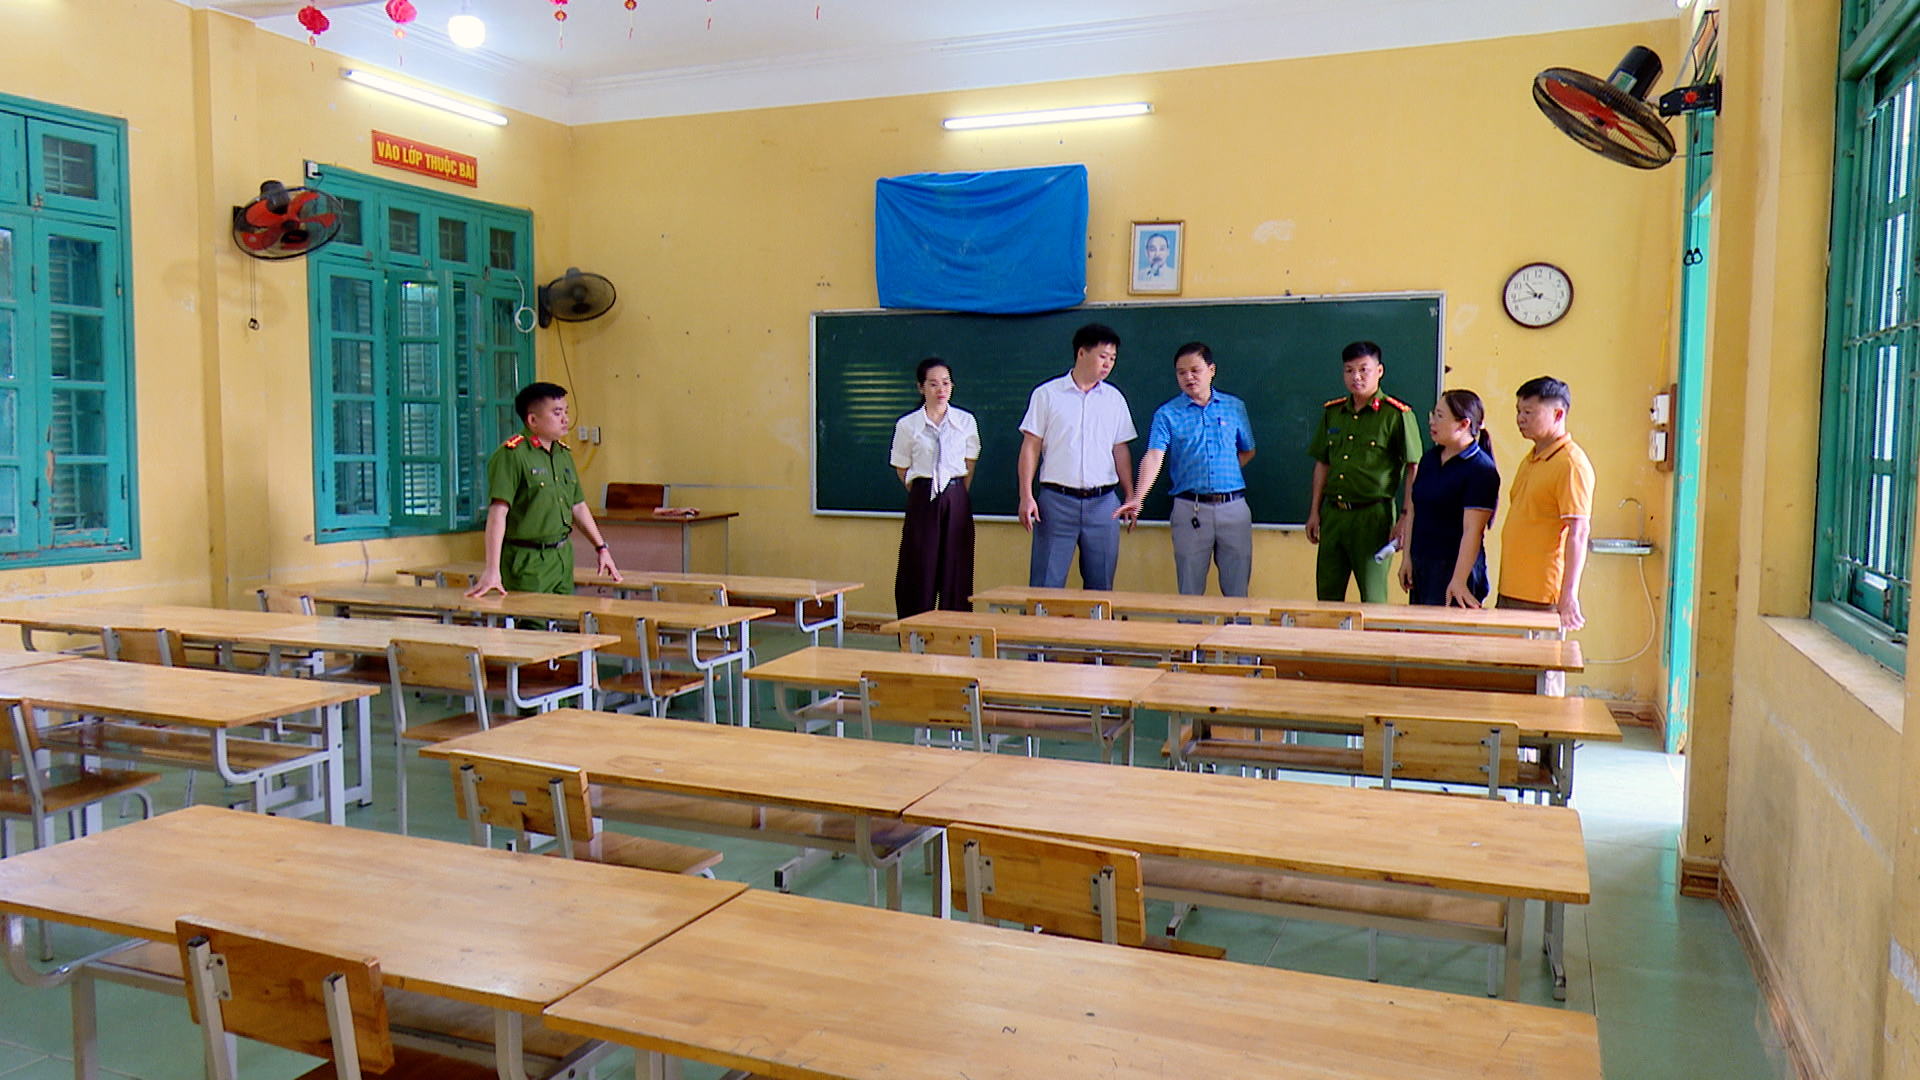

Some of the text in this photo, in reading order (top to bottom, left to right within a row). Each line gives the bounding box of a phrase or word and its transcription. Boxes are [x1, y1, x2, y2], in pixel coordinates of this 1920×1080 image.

[376, 139, 475, 180] VÀO LỚP THUỘC BÀI
[1522, 273, 1529, 281] 11
[1534, 268, 1543, 278] 12
[1513, 282, 1522, 290] 10
[1557, 279, 1562, 288] 2
[1534, 315, 1541, 323] 6
